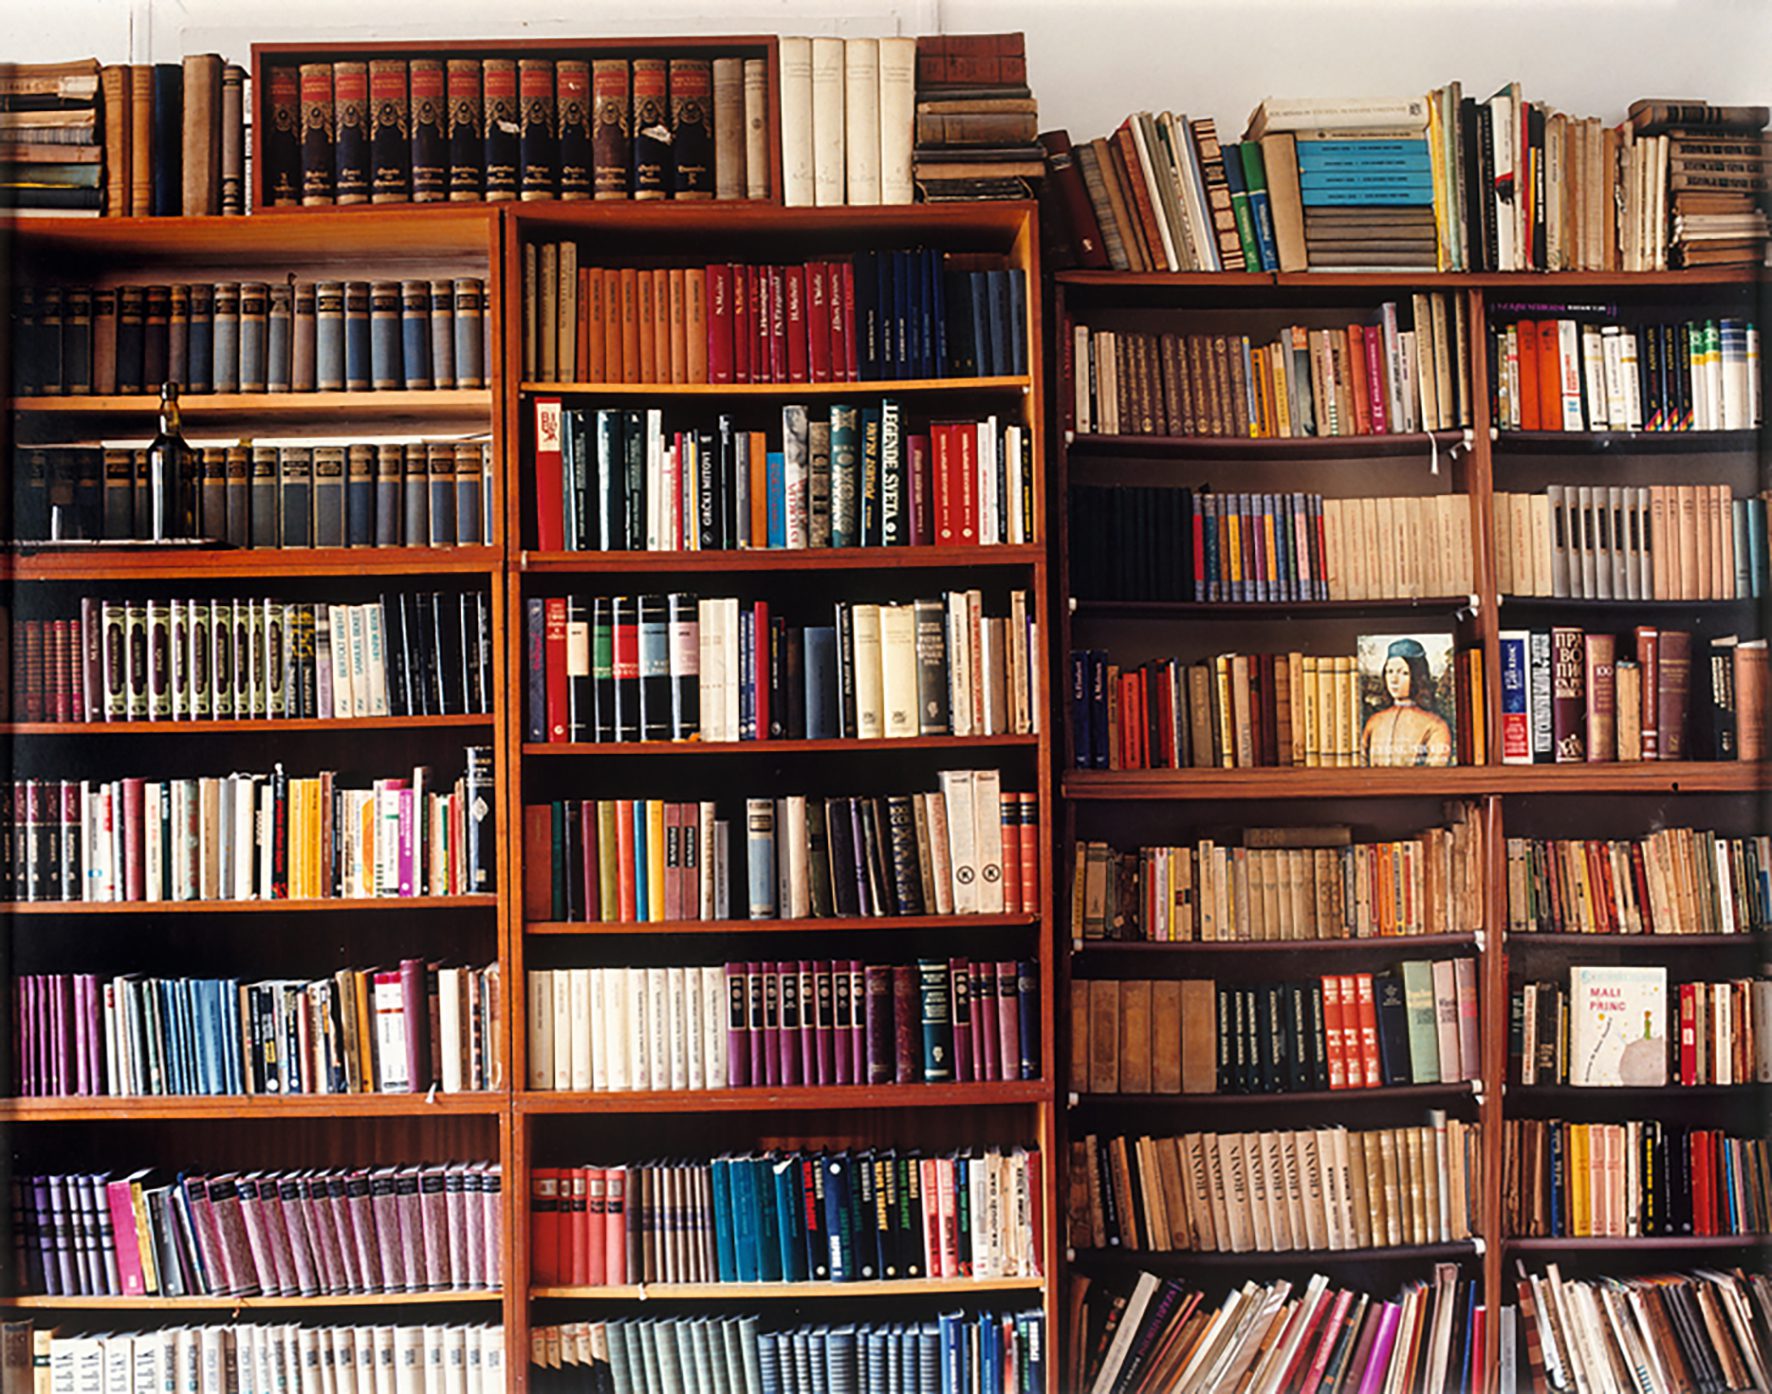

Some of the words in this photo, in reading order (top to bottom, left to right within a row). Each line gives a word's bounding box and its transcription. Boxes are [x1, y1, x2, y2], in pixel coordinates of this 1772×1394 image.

[885, 405, 899, 469] LEGENDE
[701, 451, 712, 489] MITOVI
[885, 473, 899, 518] SVETA
[701, 492, 712, 526] GRČKI
[1597, 666, 1613, 676] 100
[1589, 987, 1621, 998] MALI
[1589, 1001, 1626, 1011] PRINC
[1191, 1144, 1208, 1201] CRONIN
[1230, 1145, 1246, 1203] CRONIN
[1250, 1144, 1266, 1201] CRONIN
[1269, 1143, 1284, 1201] CRONIN
[1285, 1144, 1300, 1200] CRONIN
[1305, 1142, 1321, 1198] CRONIN
